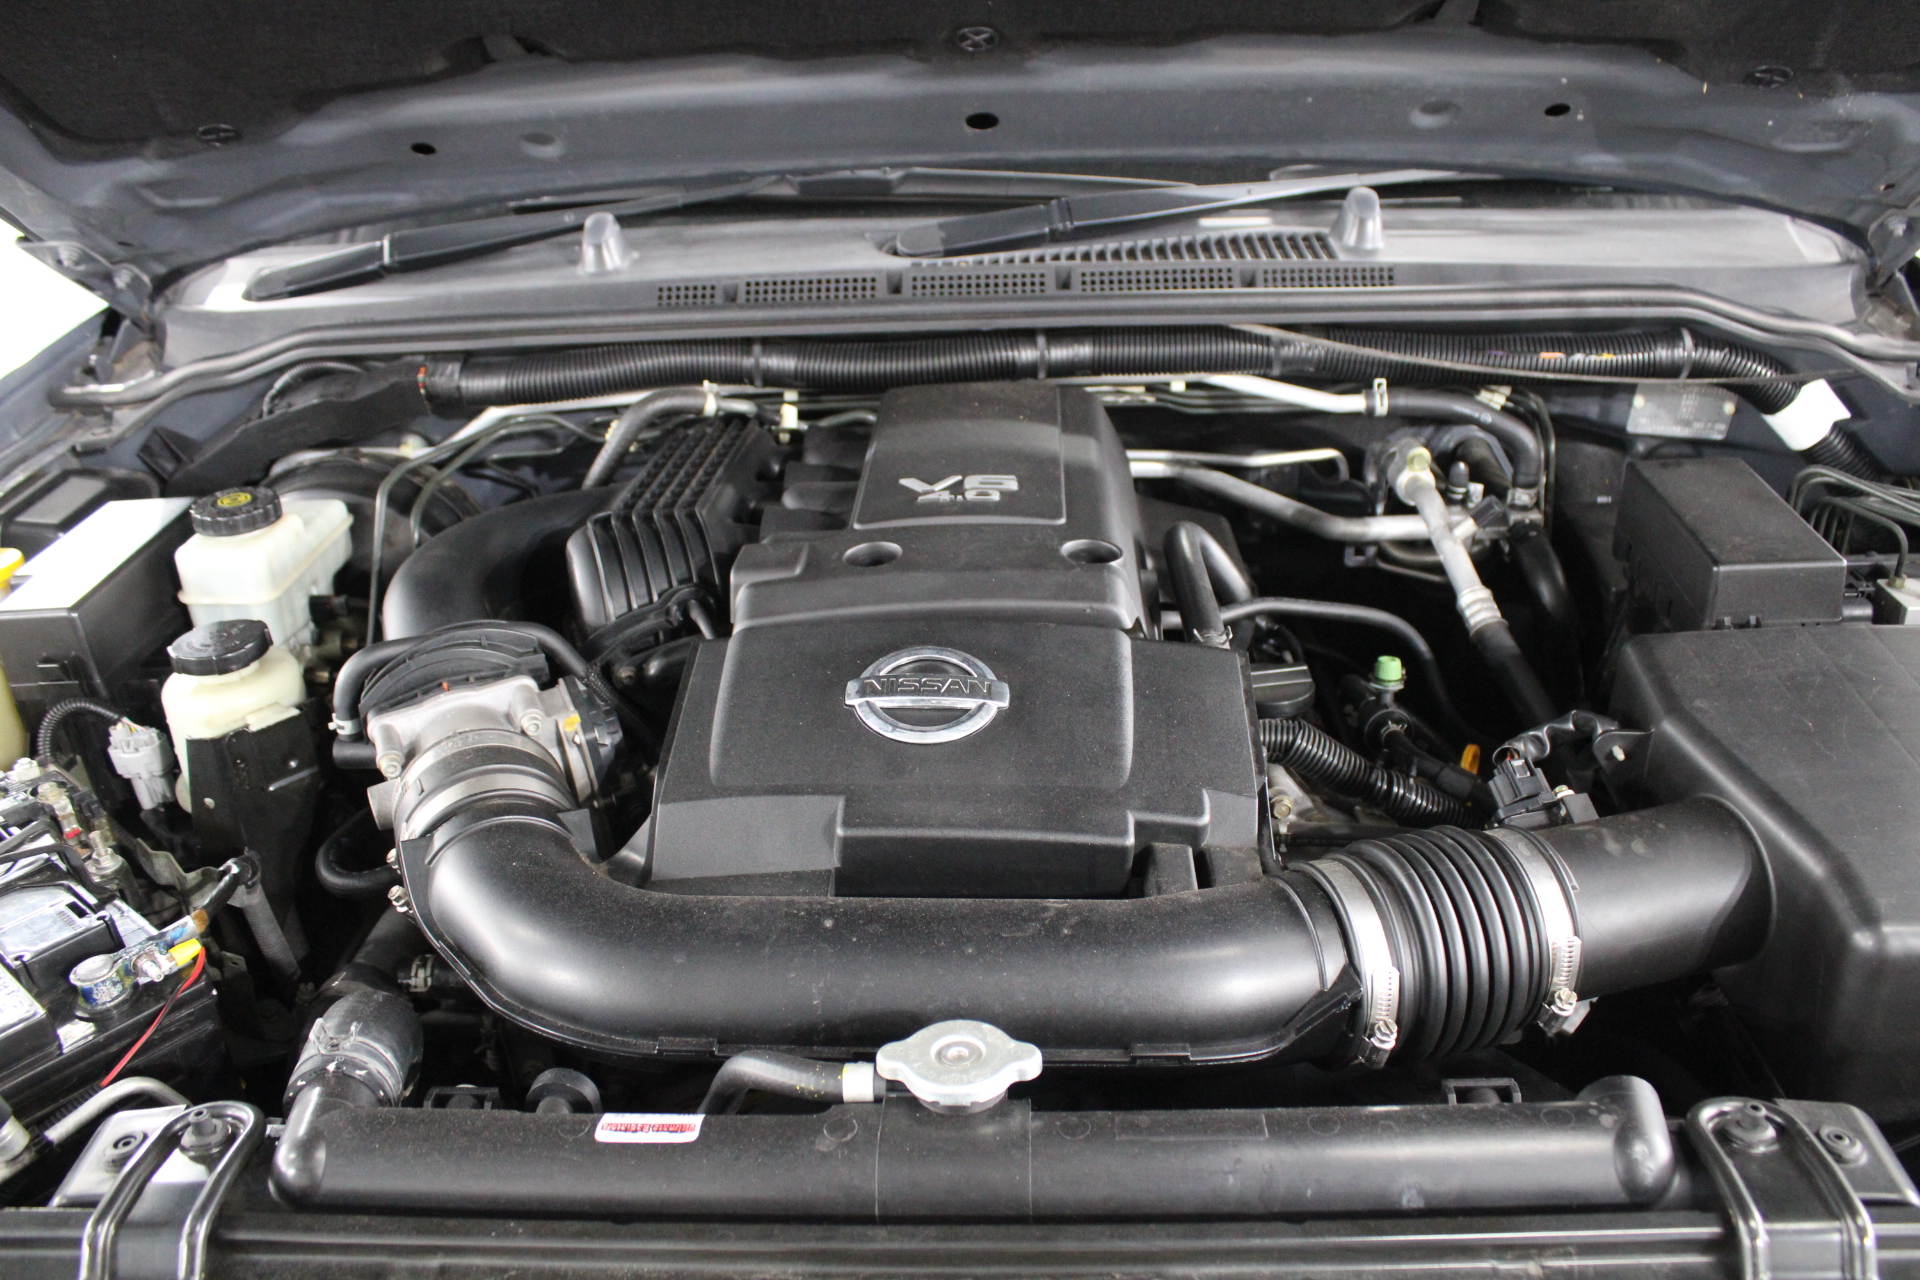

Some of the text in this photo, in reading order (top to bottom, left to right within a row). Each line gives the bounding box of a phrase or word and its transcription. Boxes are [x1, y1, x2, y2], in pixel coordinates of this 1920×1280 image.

[899, 474, 1019, 493] V6
[917, 489, 1001, 503] 4.0
[863, 677, 992, 697] NISSAN
